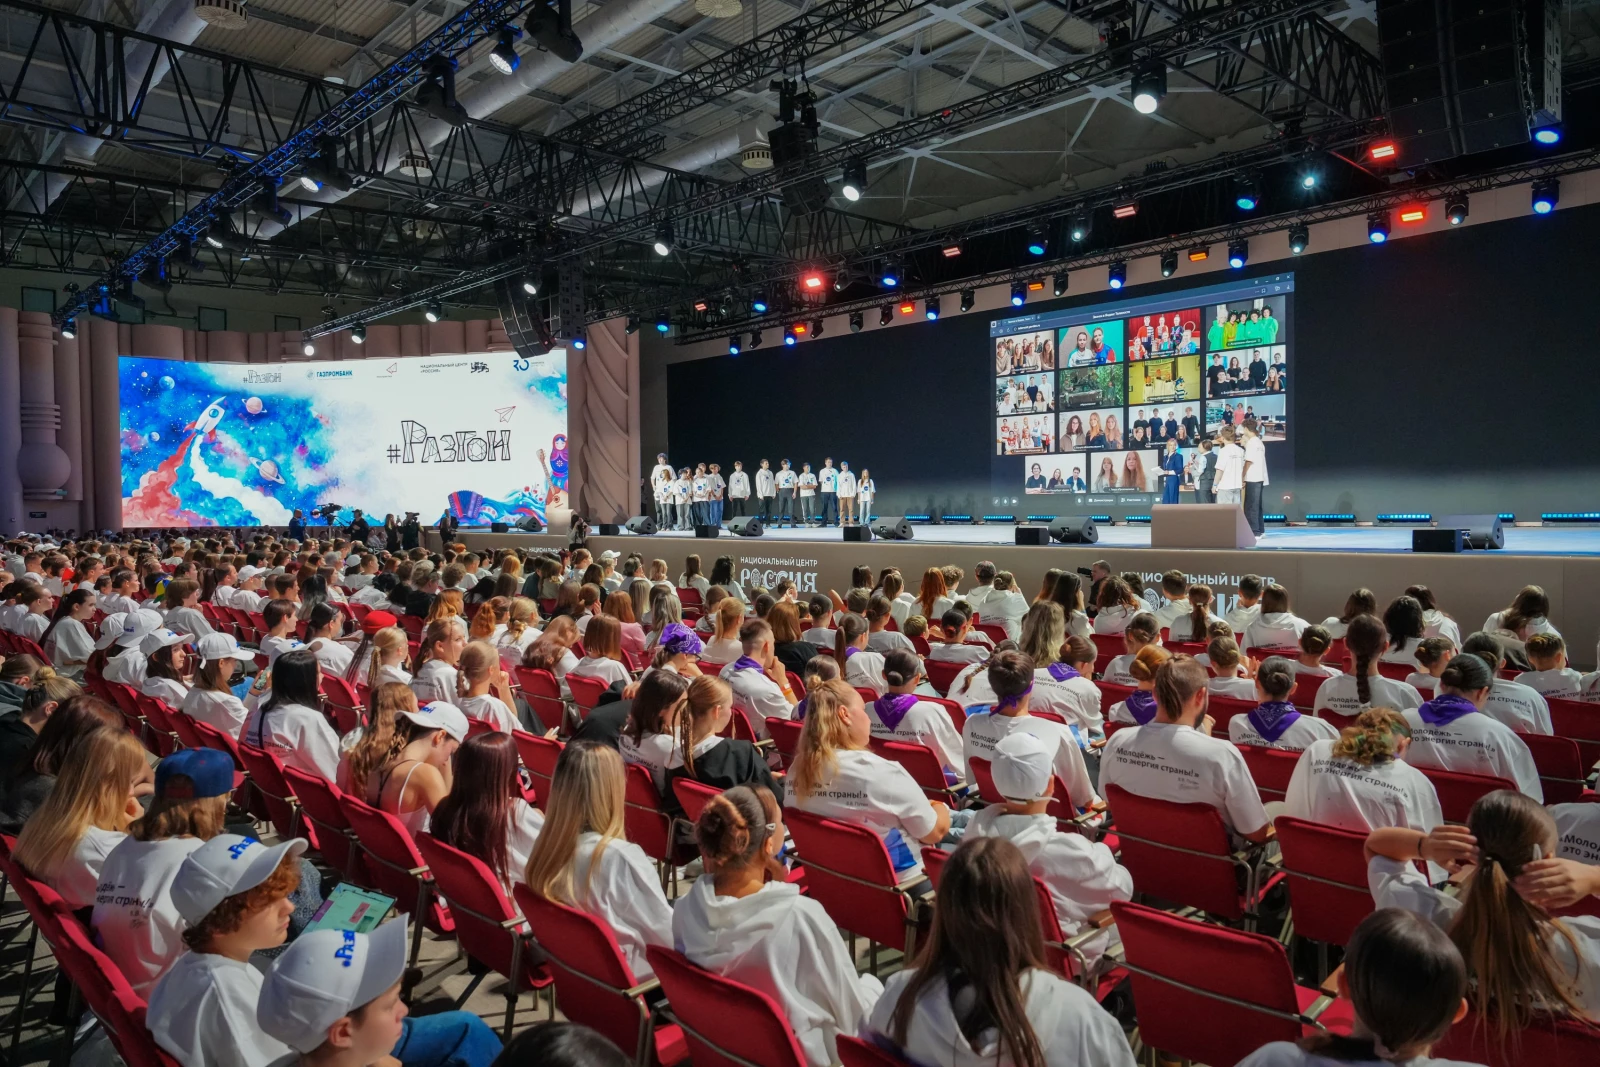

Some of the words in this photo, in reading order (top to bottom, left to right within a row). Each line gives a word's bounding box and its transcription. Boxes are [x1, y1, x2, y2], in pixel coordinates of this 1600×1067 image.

[316, 370, 353, 378] ГАЗПРОМБАНК
[740, 556, 795, 567] НАЦИОНАЛЬНЫЙ
[795, 559, 818, 568] ЦЕНТР
[740, 568, 818, 593] РОССИЯ
[970, 731, 999, 745] Молодёж
[979, 743, 996, 752] энер
[1116, 747, 1156, 760] Молодёжь
[1128, 758, 1160, 770] энергия
[1324, 767, 1363, 781] энергия
[1562, 846, 1582, 856] это
